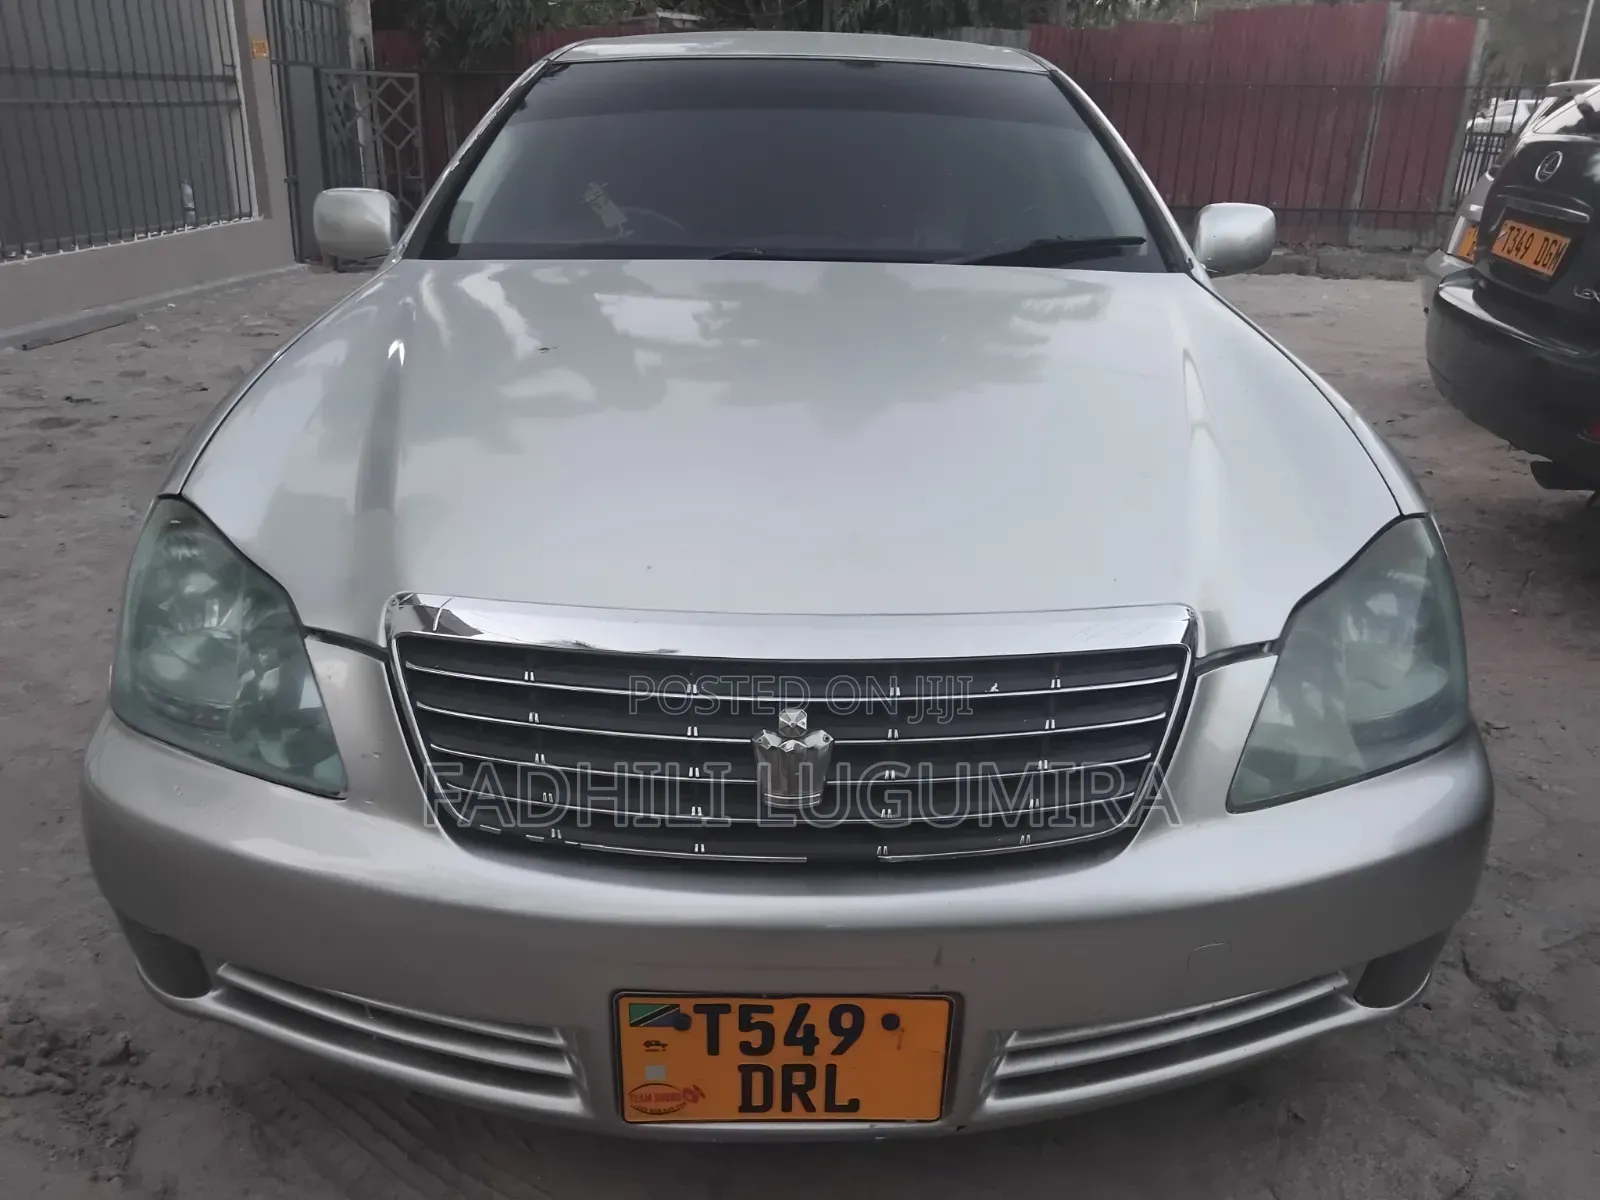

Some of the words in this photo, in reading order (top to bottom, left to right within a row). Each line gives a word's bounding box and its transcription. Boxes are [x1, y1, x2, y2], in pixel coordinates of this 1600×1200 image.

[1501, 226, 1535, 260] T349
[693, 1003, 865, 1056] T549
[738, 1063, 861, 1113] DRL
